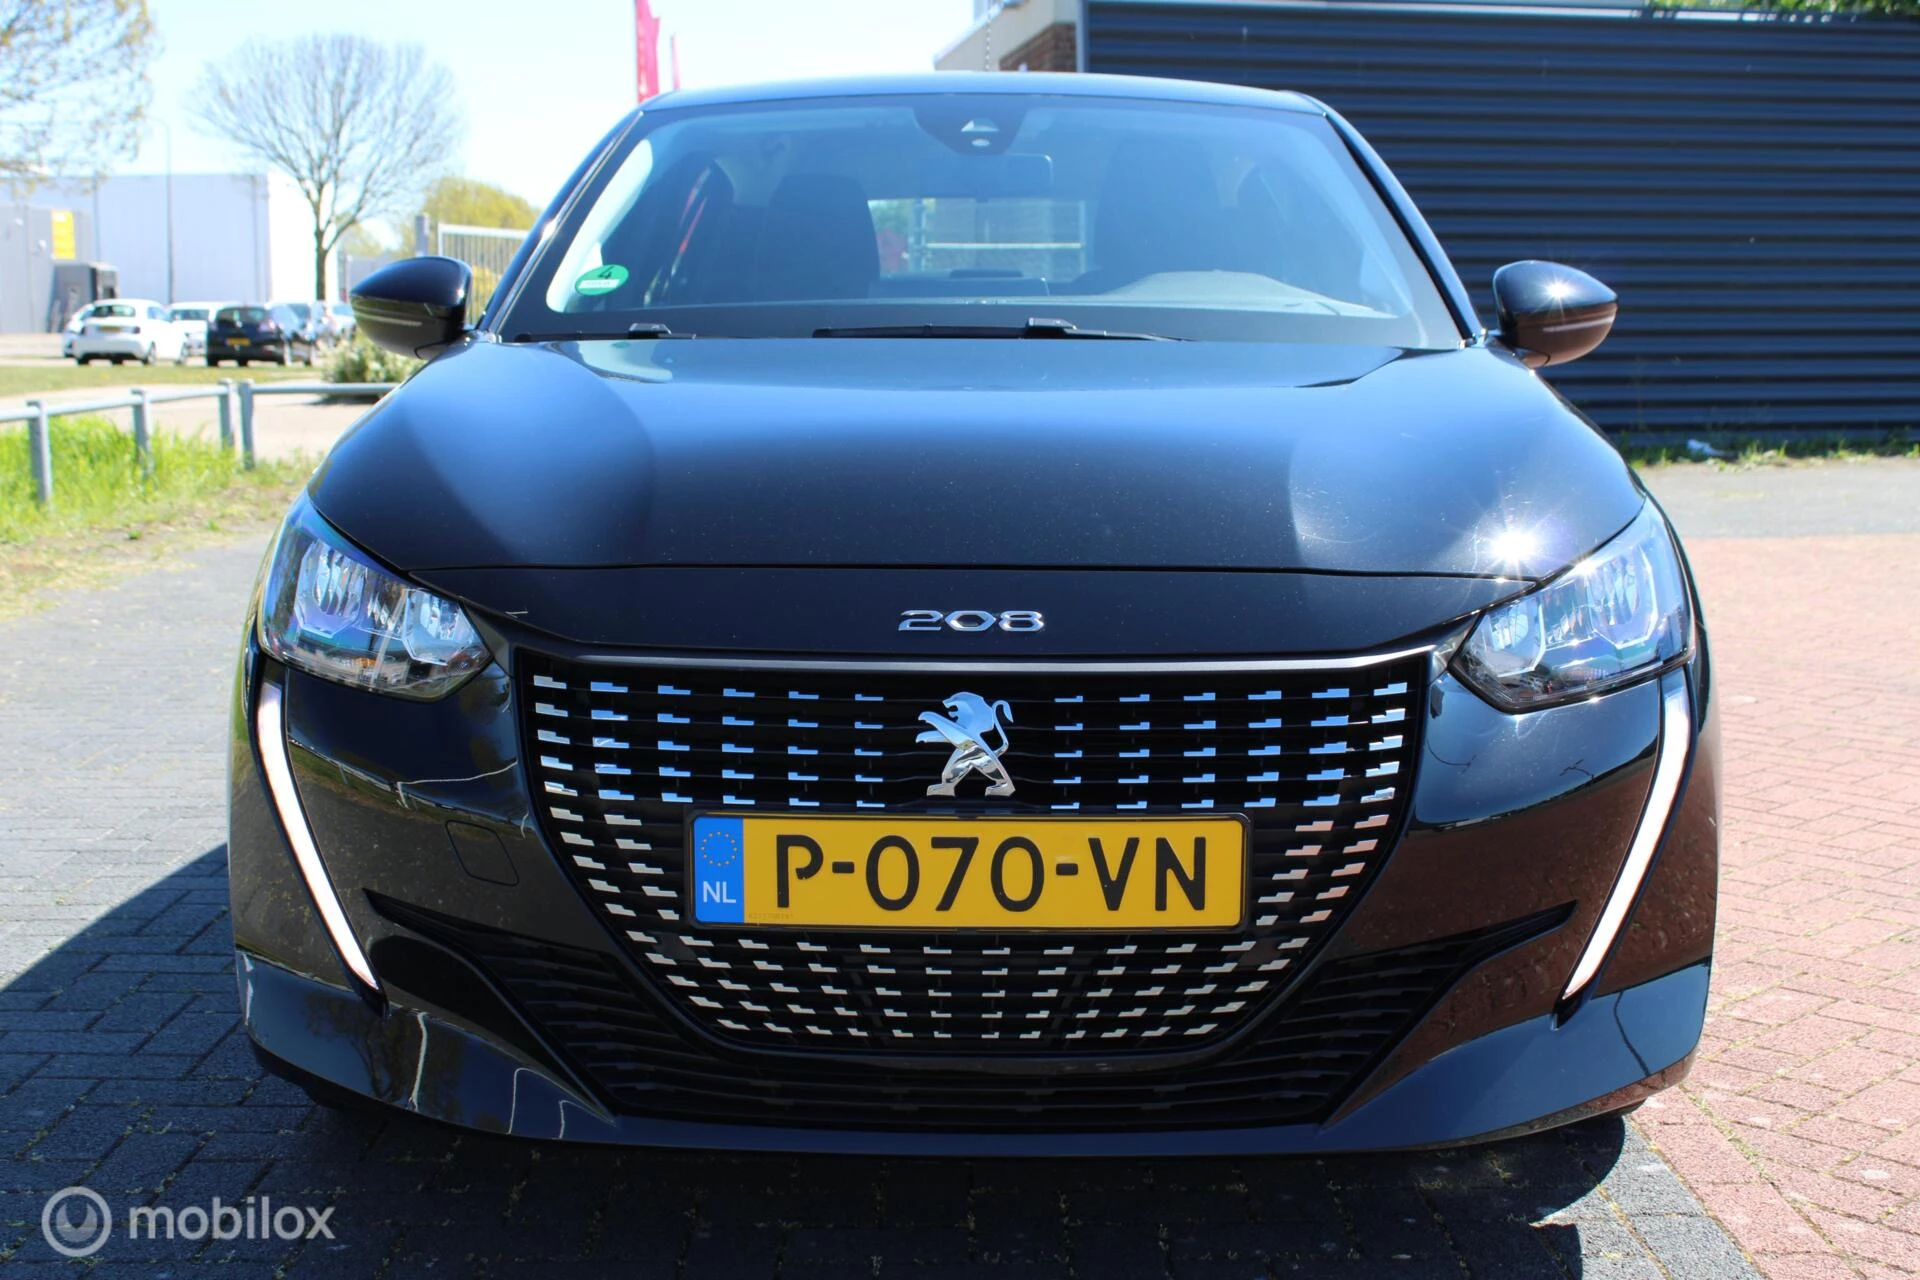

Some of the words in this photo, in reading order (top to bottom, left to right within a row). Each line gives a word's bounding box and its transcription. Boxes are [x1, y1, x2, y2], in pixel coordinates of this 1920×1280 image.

[598, 265, 615, 279] 4
[898, 609, 1044, 632] 208
[776, 834, 1206, 912] P-070-VN
[702, 881, 737, 904] NL
